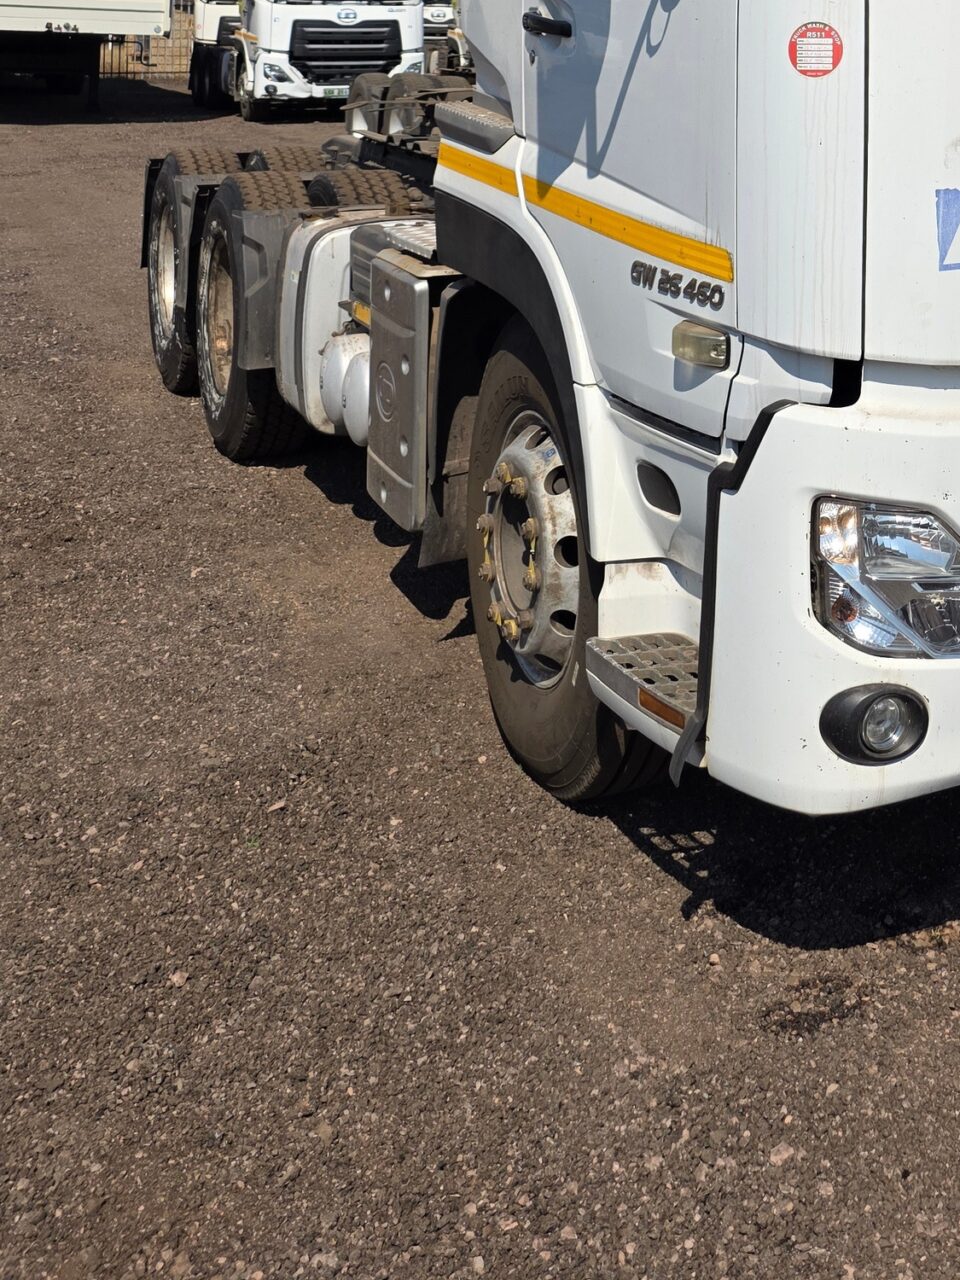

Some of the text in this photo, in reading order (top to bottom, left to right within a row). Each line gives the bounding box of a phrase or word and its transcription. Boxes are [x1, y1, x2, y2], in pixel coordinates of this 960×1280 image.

[791, 26, 807, 42] TRUCK
[631, 260, 725, 312] GW 26 460
